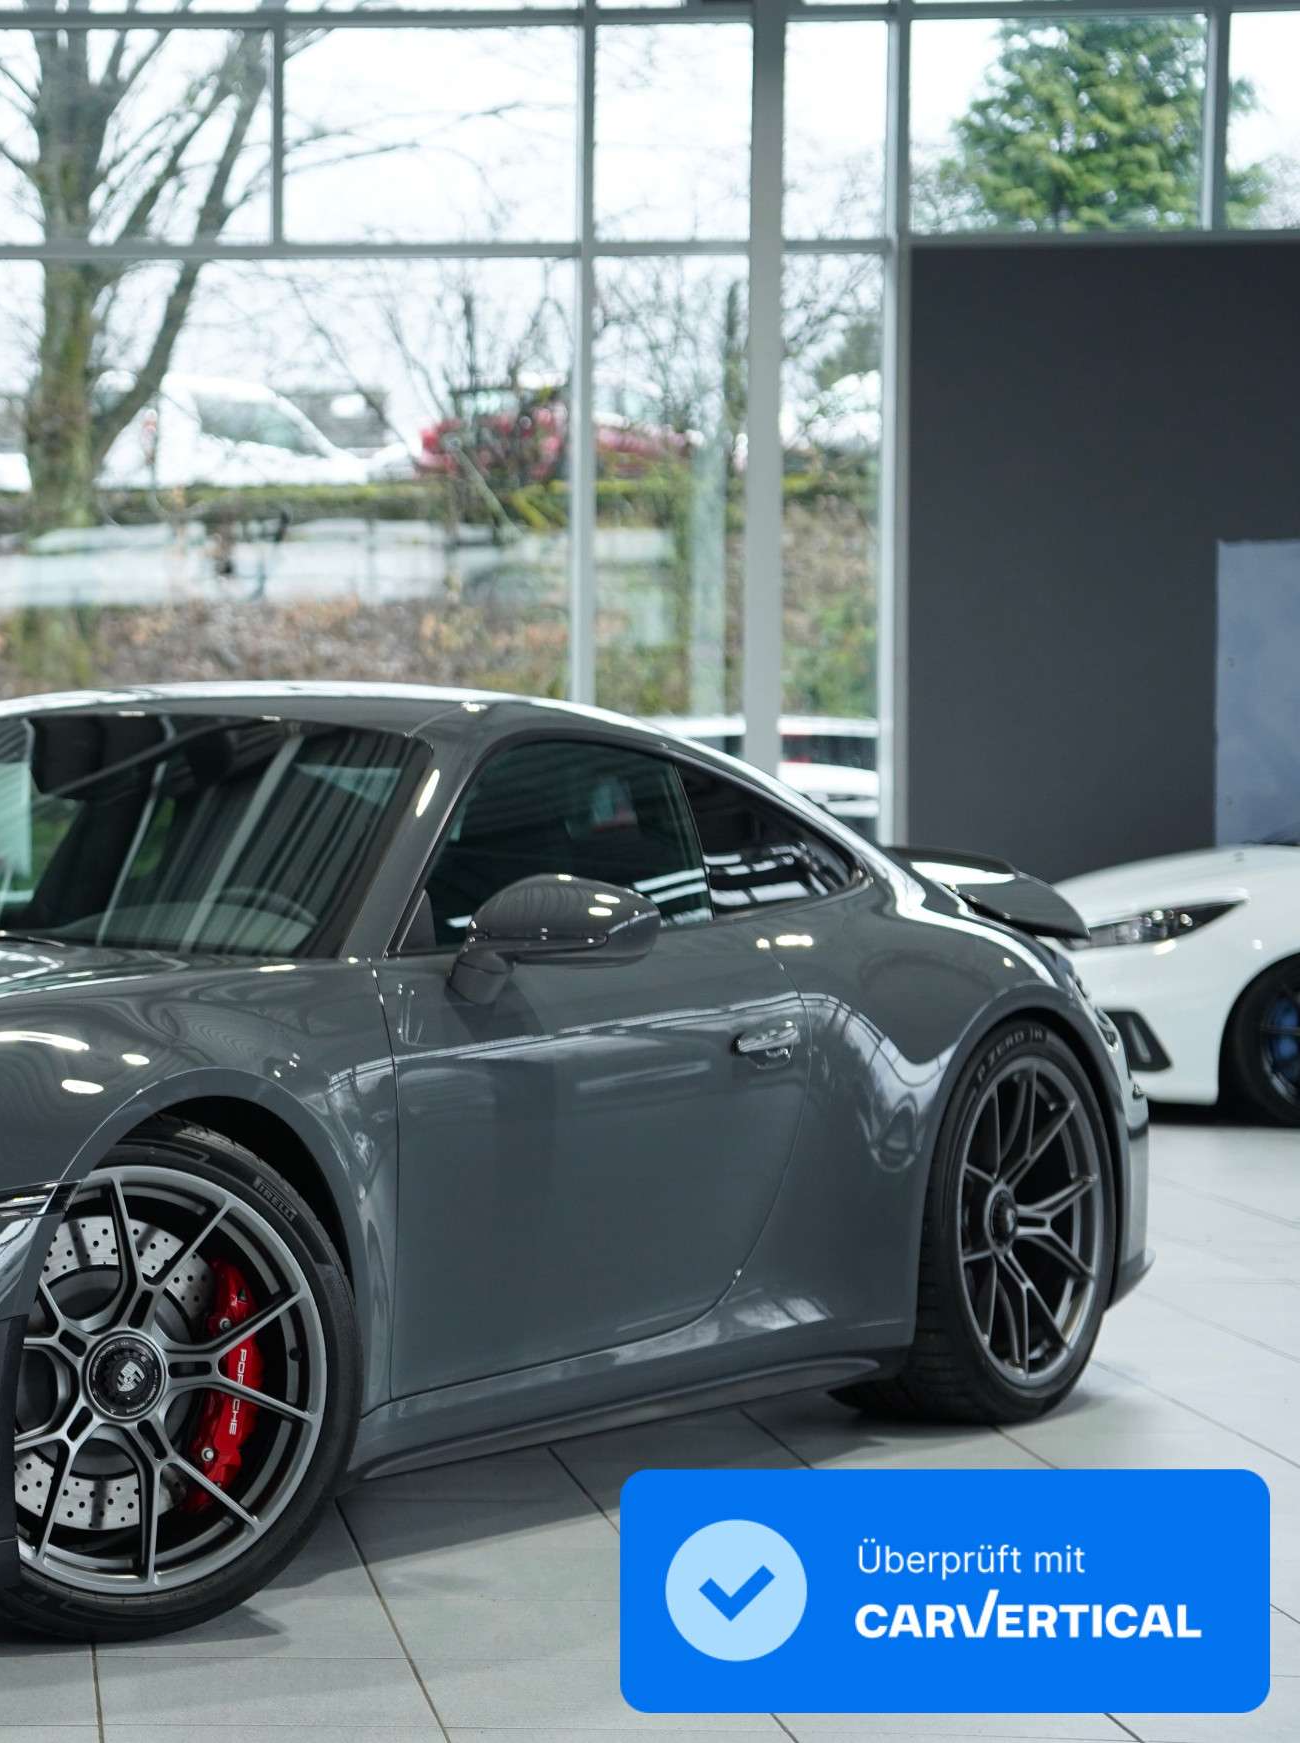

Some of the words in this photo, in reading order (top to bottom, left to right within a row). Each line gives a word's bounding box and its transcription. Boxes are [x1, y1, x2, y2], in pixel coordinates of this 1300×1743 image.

[987, 1029, 1026, 1067] ZERO
[252, 1175, 299, 1223] PIRELLI
[229, 1348, 248, 1435] PORCHE
